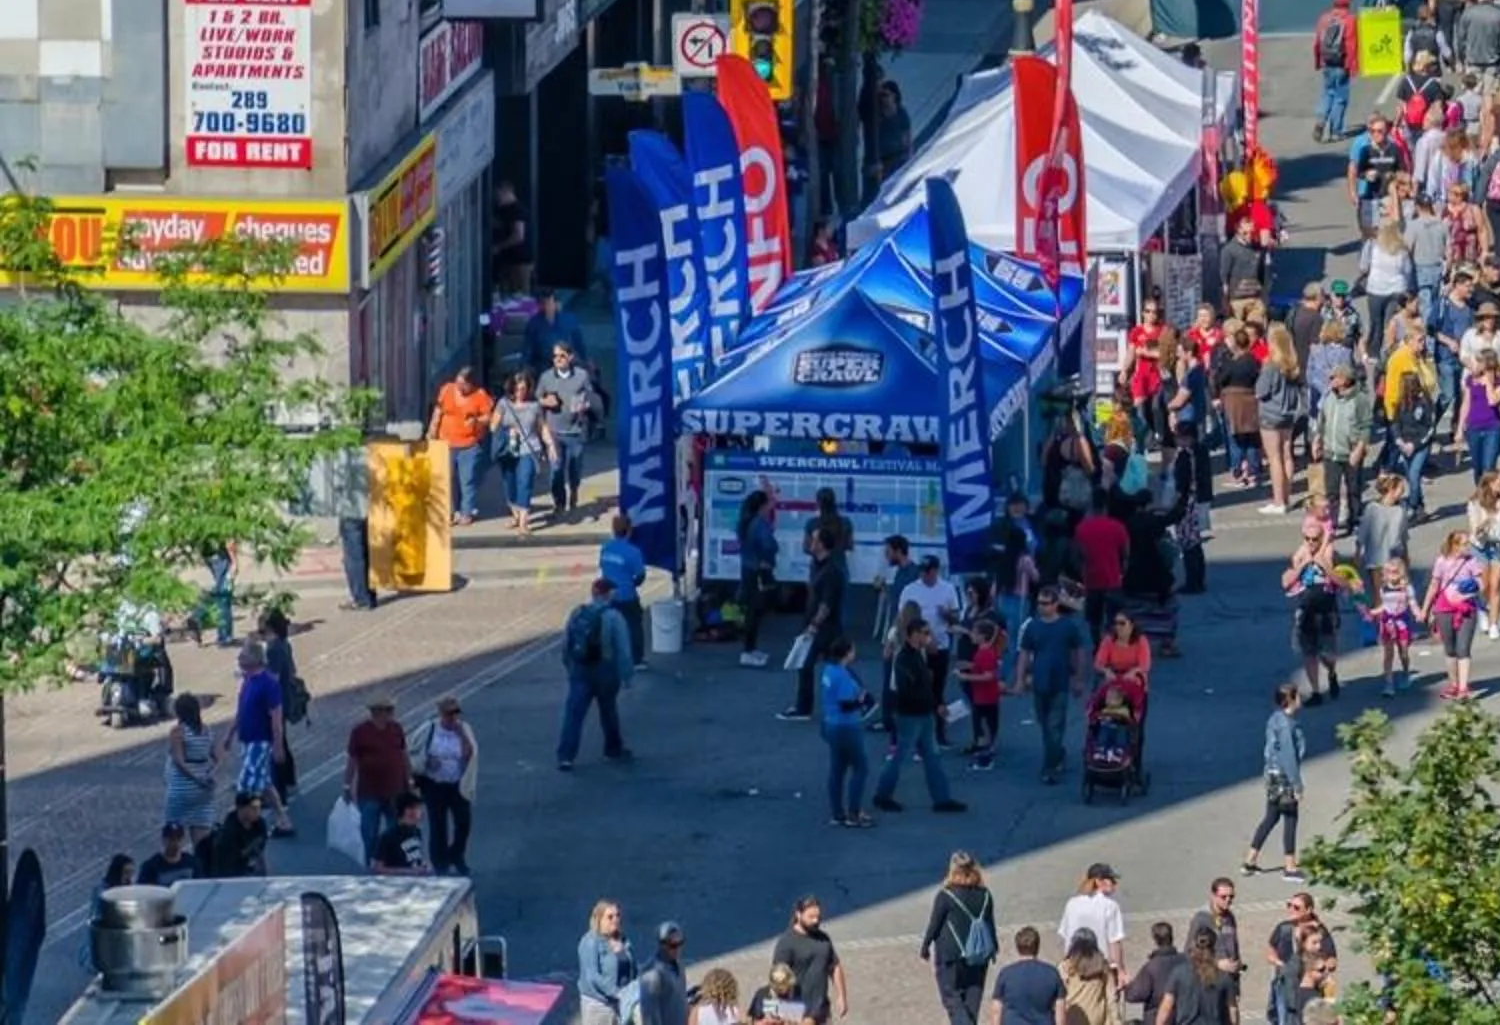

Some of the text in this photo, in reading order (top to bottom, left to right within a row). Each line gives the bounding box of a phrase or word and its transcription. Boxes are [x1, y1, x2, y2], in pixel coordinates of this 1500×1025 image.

[240, 11, 253, 25] 2
[200, 27, 297, 43] LIVE/WORK
[201, 46, 277, 61] STUDIOS
[191, 63, 305, 80] APARTMENTS
[231, 91, 268, 110] 289
[193, 111, 306, 134] 700-9680
[194, 141, 303, 162] FOR RENT
[740, 145, 782, 317] NFO
[615, 241, 666, 528] MERCH
[935, 250, 992, 538] MERCH
[681, 408, 940, 441] SUPERCRAW
[759, 455, 861, 470] SUPERCRAWL
